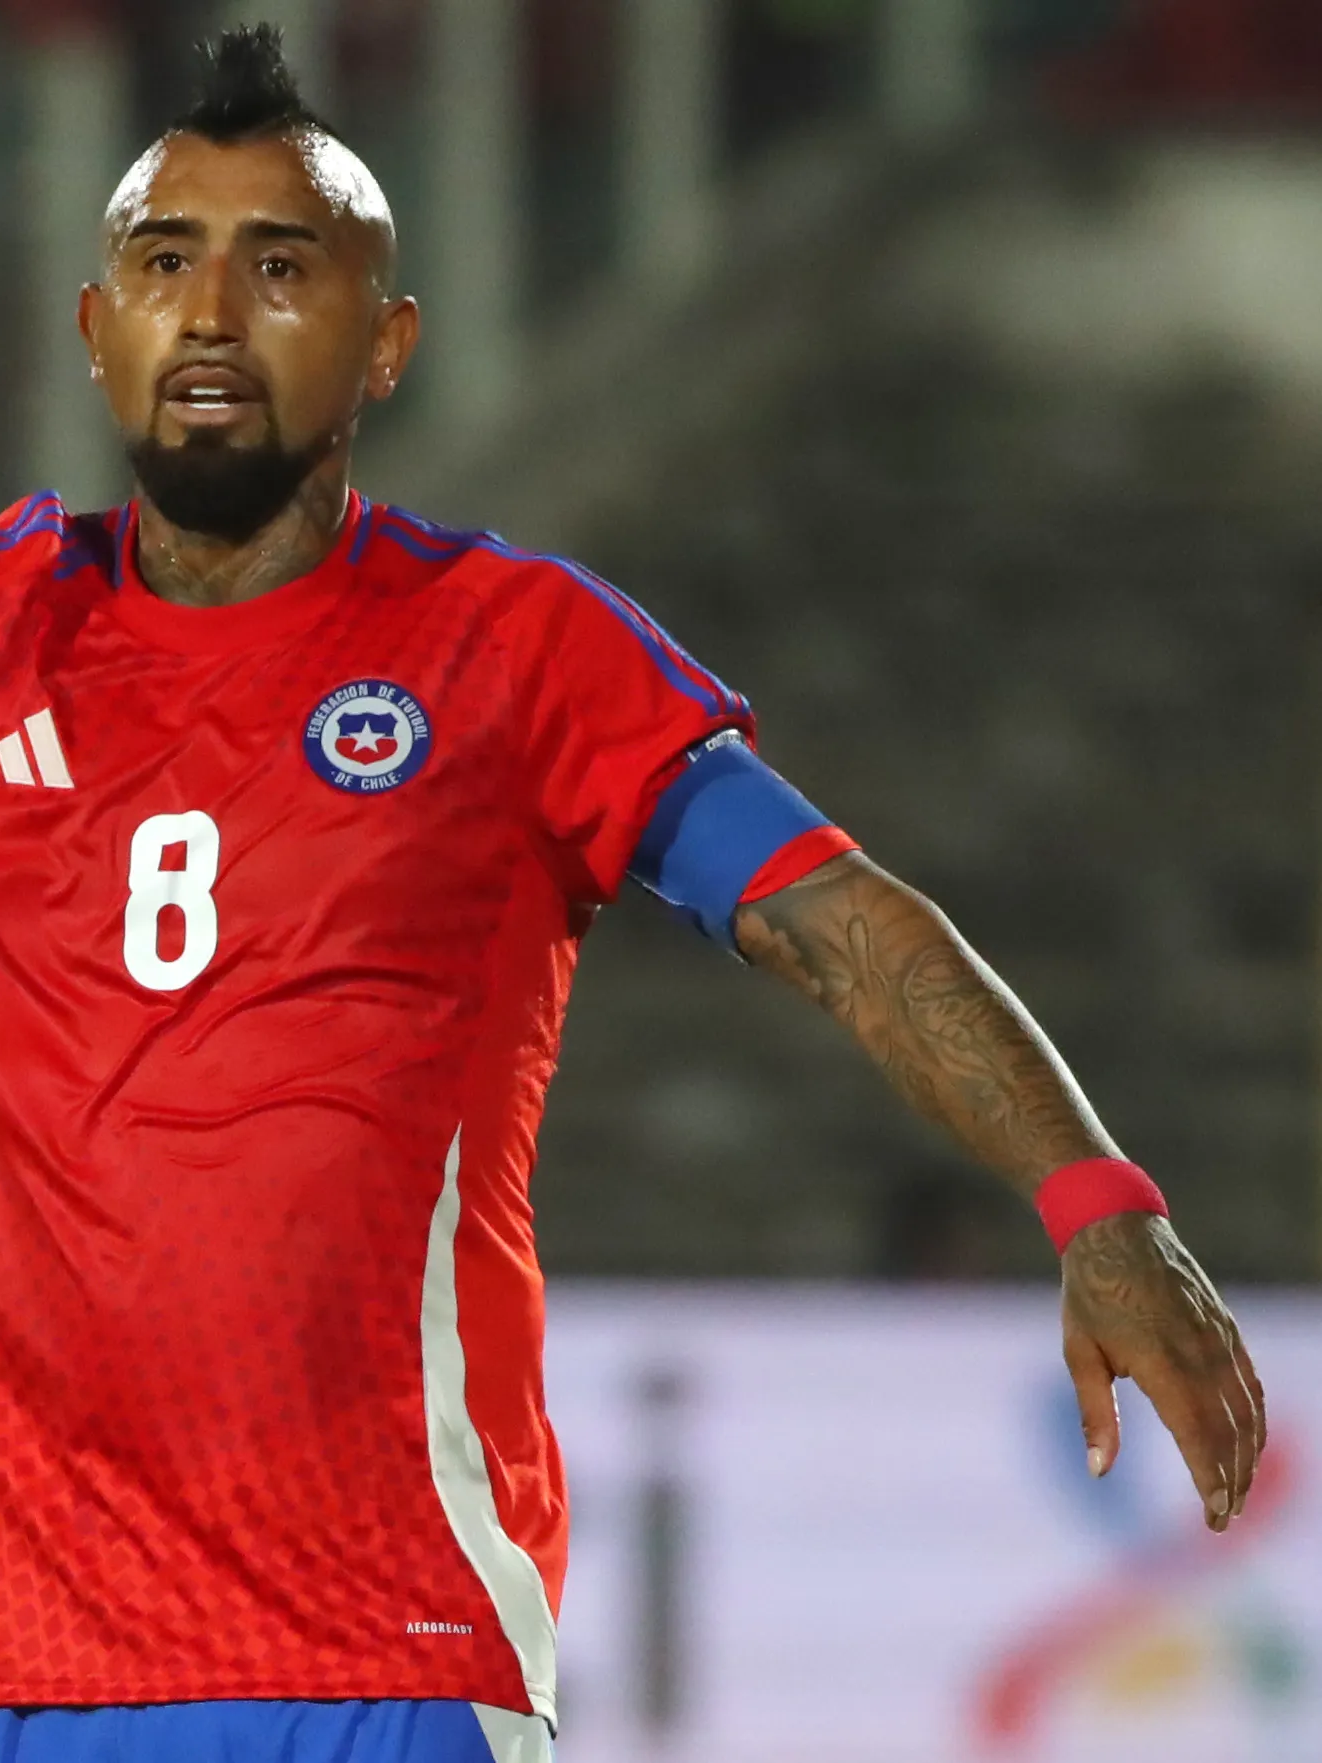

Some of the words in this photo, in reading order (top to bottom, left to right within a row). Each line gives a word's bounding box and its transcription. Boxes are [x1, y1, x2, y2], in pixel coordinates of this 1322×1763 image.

[307, 684, 368, 739] FEDERACION
[378, 684, 396, 700] DE
[398, 696, 428, 740] FUTBOL
[334, 773, 353, 787] DE
[361, 773, 399, 790] CHILE
[123, 810, 220, 991] 8
[406, 1621, 473, 1635] AEROREADY
